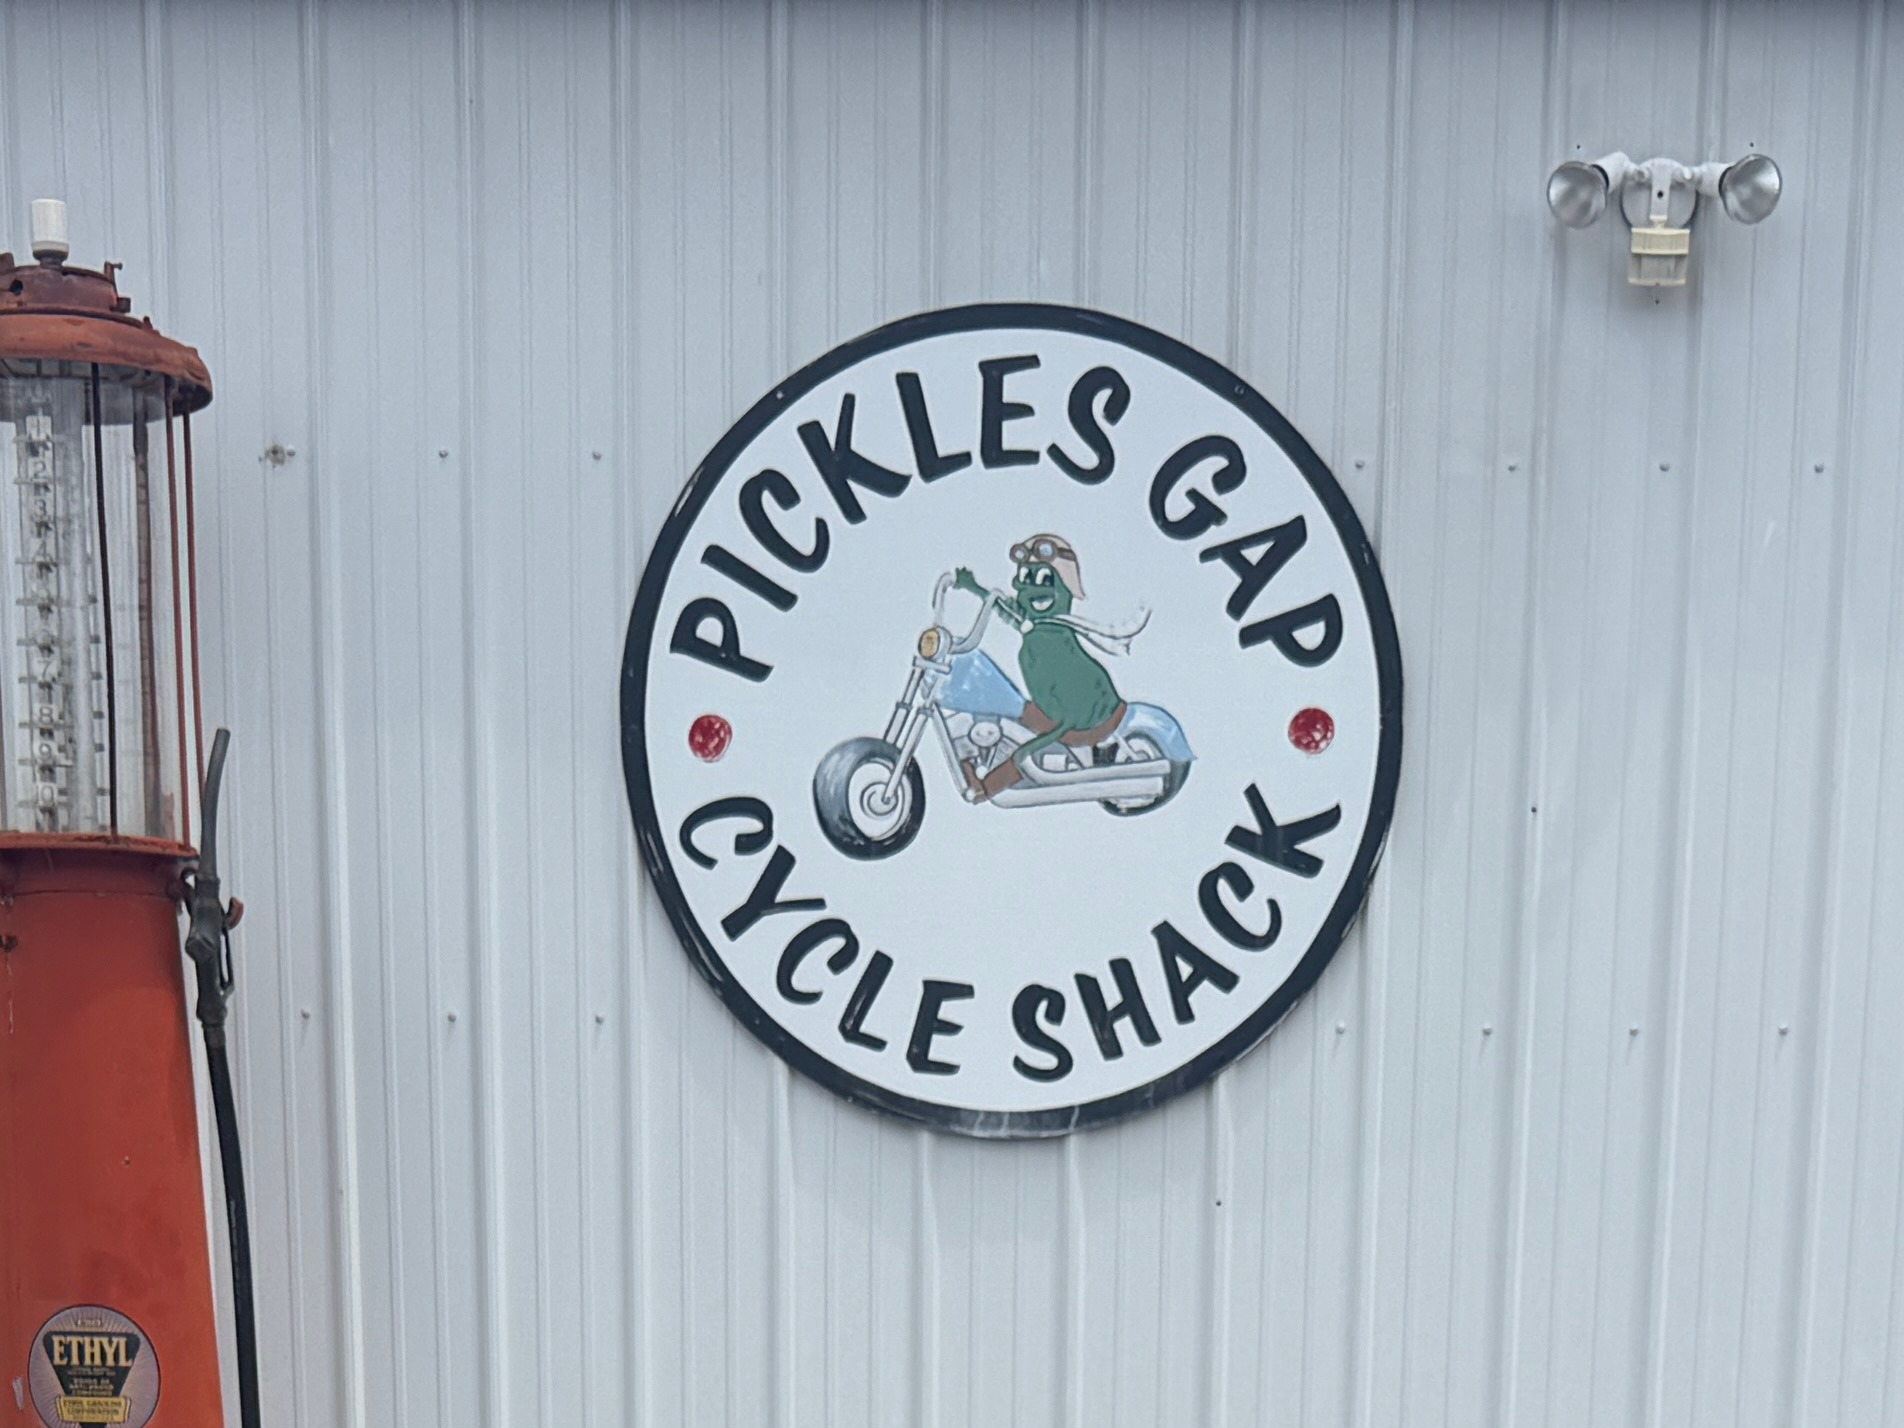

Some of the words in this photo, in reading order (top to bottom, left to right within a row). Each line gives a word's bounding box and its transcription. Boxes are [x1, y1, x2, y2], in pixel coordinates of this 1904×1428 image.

[669, 355, 1131, 682] PICKLES
[1149, 435, 1343, 668] GAP
[680, 797, 974, 1074] CYCLE
[1012, 784, 1341, 1081] SHACK
[52, 1335, 133, 1367] ETHYL
